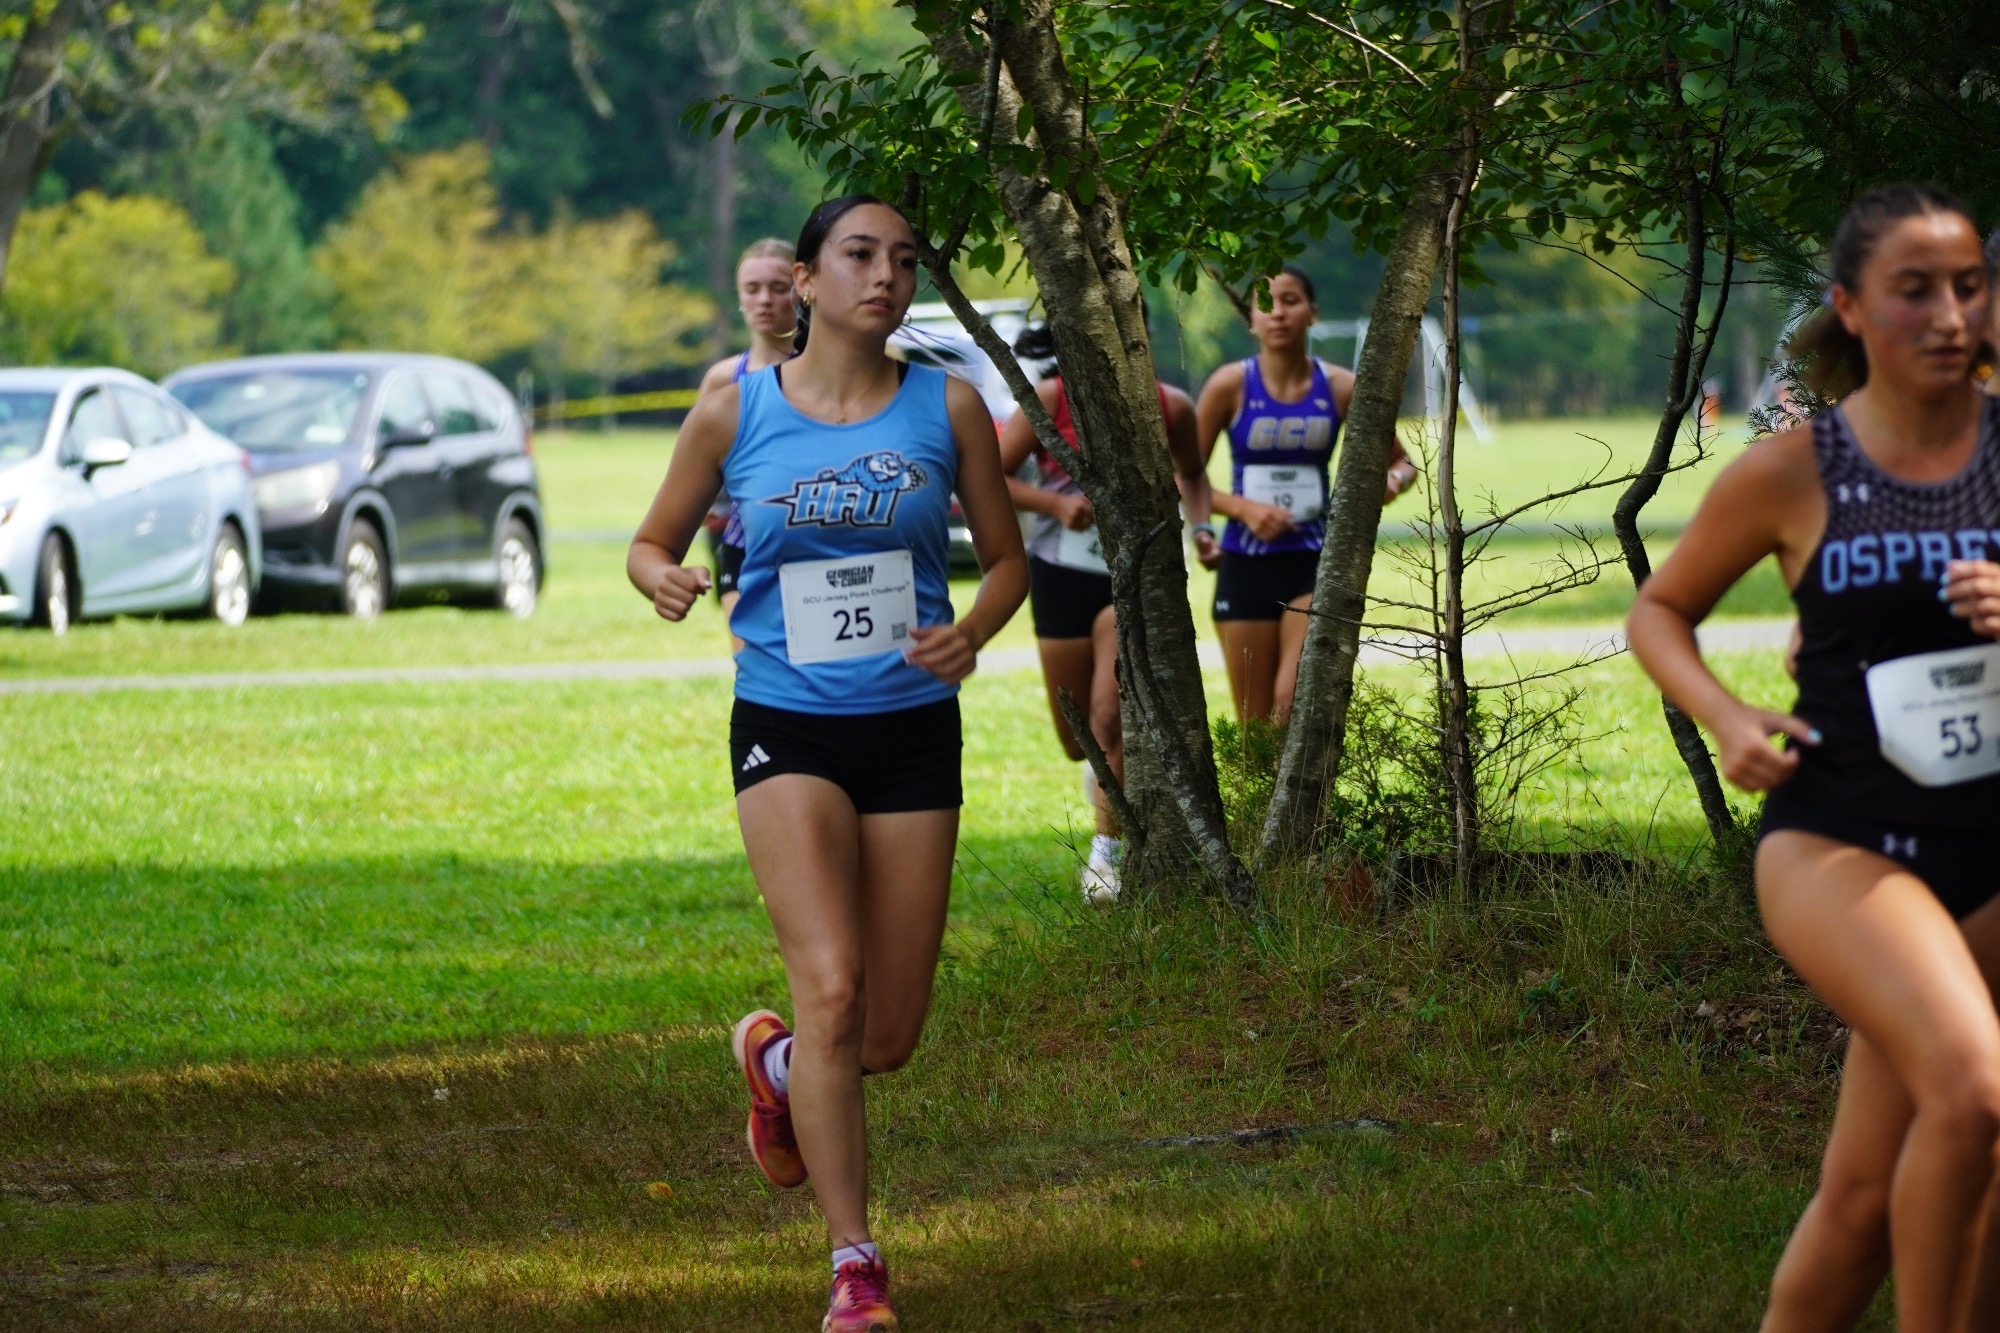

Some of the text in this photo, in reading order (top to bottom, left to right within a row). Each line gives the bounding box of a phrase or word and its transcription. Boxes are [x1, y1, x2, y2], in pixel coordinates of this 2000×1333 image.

[787, 478, 900, 528] HFU
[826, 565, 874, 581] GEORGIAN
[841, 576, 873, 588] COURT
[823, 594, 848, 603] Jersey
[871, 585, 906, 596] Challenge
[833, 606, 874, 641] 25
[1941, 715, 1983, 758] 53
